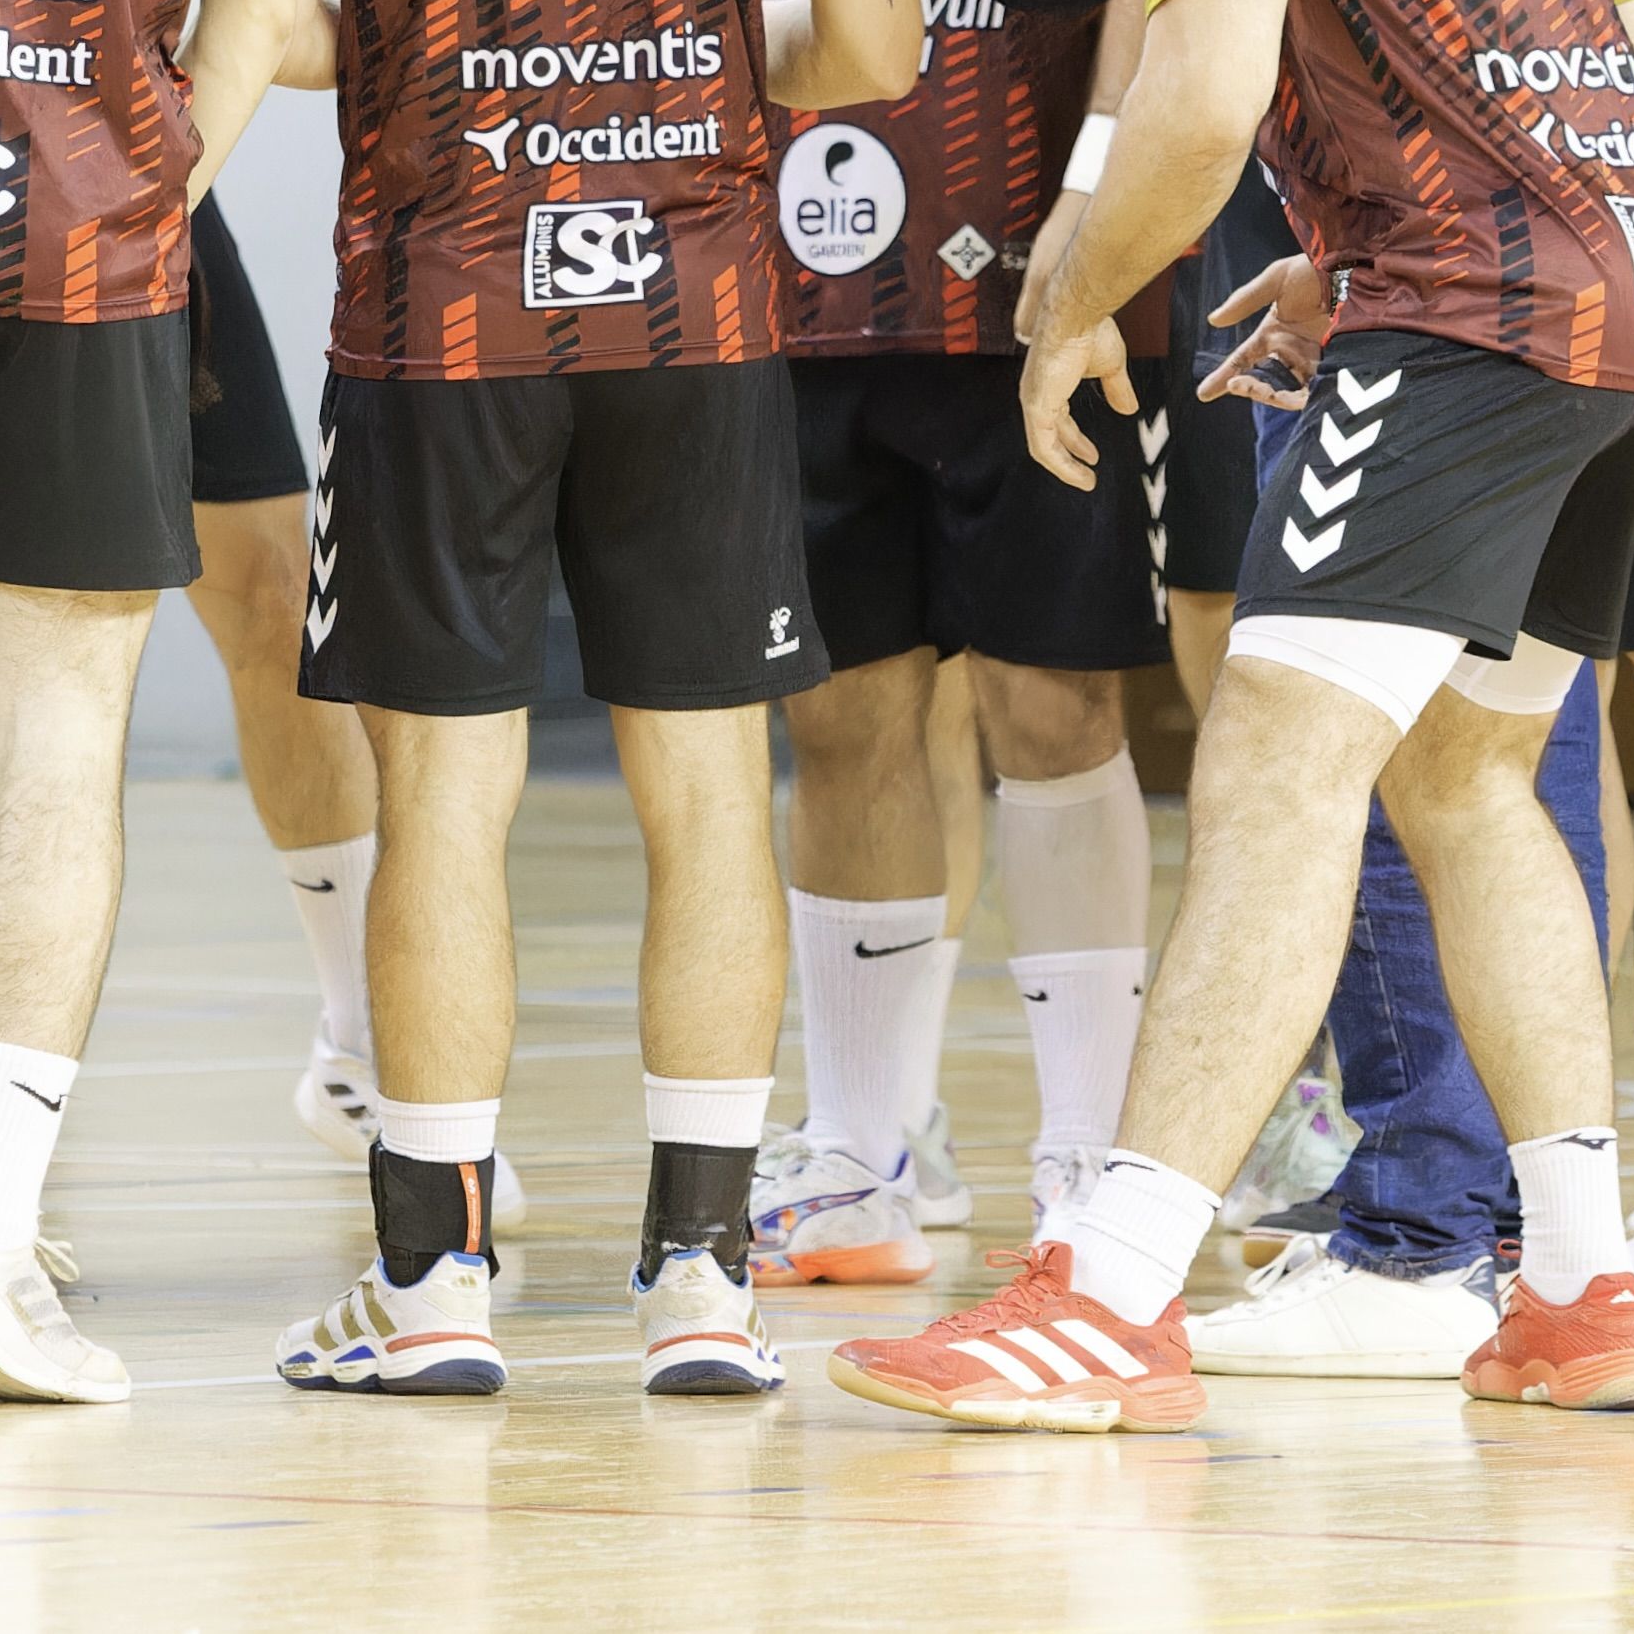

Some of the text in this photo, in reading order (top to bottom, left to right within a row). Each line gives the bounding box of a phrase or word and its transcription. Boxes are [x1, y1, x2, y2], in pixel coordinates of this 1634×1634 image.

[461, 20, 723, 90] moventis
[525, 113, 722, 166] Occident
[796, 198, 877, 236] elia
[532, 214, 555, 299] ALUMINIS
[551, 211, 664, 296] SC
